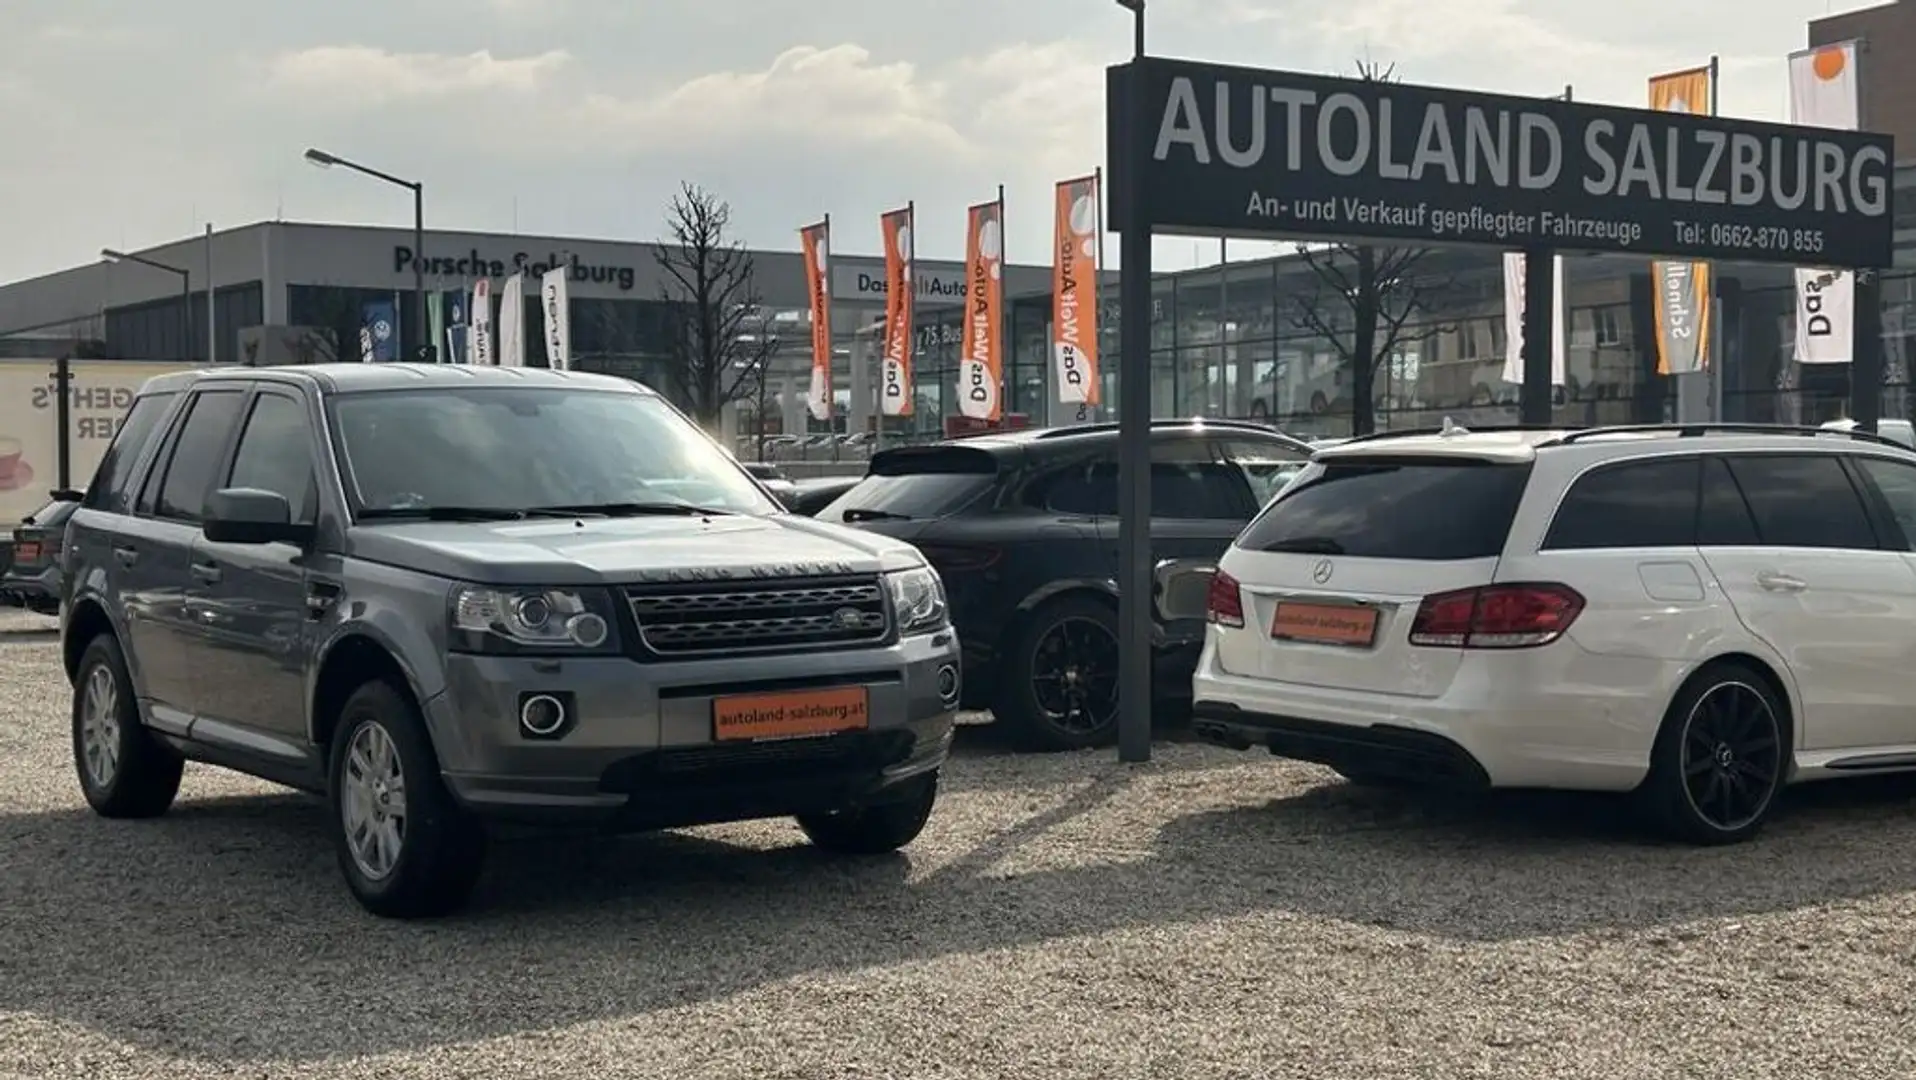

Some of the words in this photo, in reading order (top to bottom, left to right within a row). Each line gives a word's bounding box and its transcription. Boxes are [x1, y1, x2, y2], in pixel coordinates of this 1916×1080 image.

[1152, 76, 1563, 189] AUTOLAND
[1582, 118, 1887, 216] SALZBURG
[1247, 190, 1288, 216] An-
[1294, 197, 1336, 221] und
[1343, 197, 1427, 226] Verkauf
[1431, 206, 1536, 238] gepflegter
[1540, 211, 1642, 246] Fahrzeuge
[1673, 220, 1706, 244] Tel:
[1710, 223, 1789, 250] 0662-870
[1793, 229, 1824, 252] 855
[394, 246, 504, 277] Porsche
[513, 251, 635, 291] Salburg
[719, 701, 866, 726] autoland-salzburg.at
